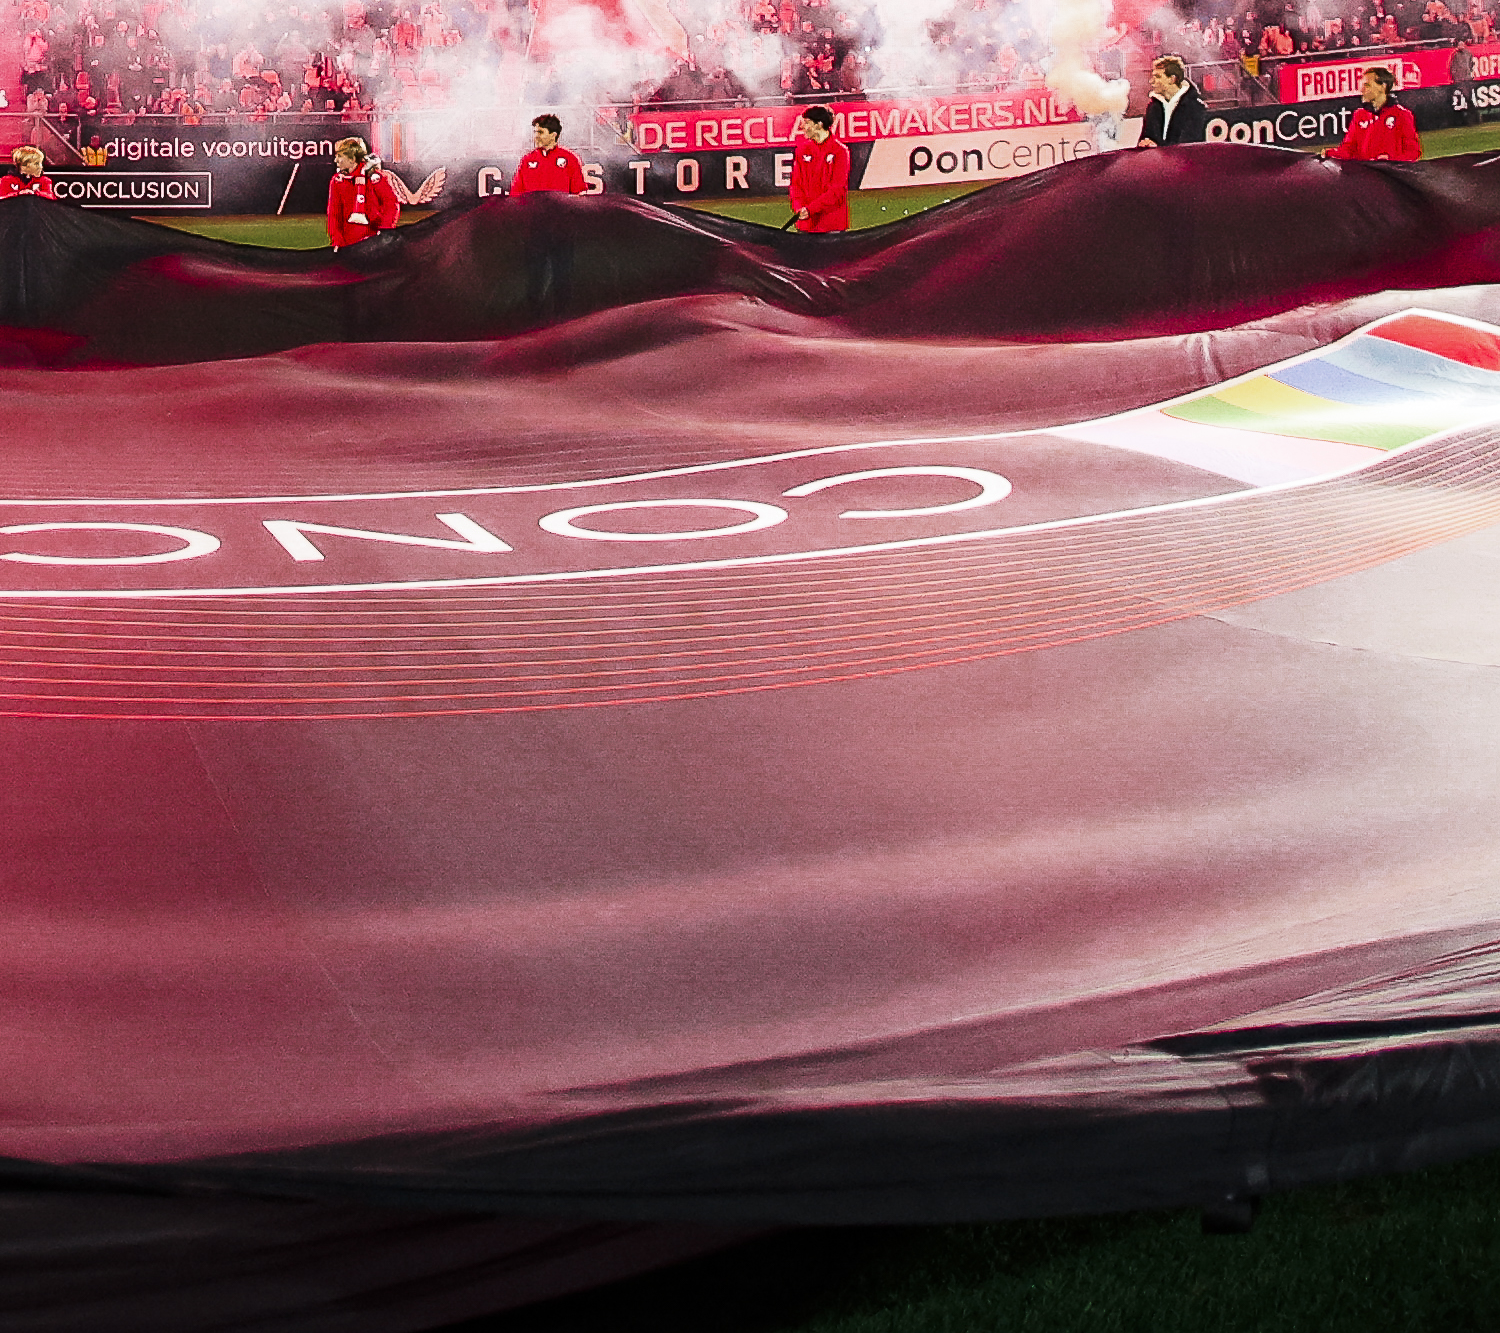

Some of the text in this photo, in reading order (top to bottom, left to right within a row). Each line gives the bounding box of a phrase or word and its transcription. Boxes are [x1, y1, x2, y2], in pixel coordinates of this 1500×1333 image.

[638, 120, 688, 150] DE
[1205, 107, 1352, 145] PonCent
[105, 136, 334, 161] digitale vooruitgan
[908, 136, 1093, 176] PonCente
[54, 181, 200, 199] CONCLUSION
[477, 152, 796, 198] CSTORE
